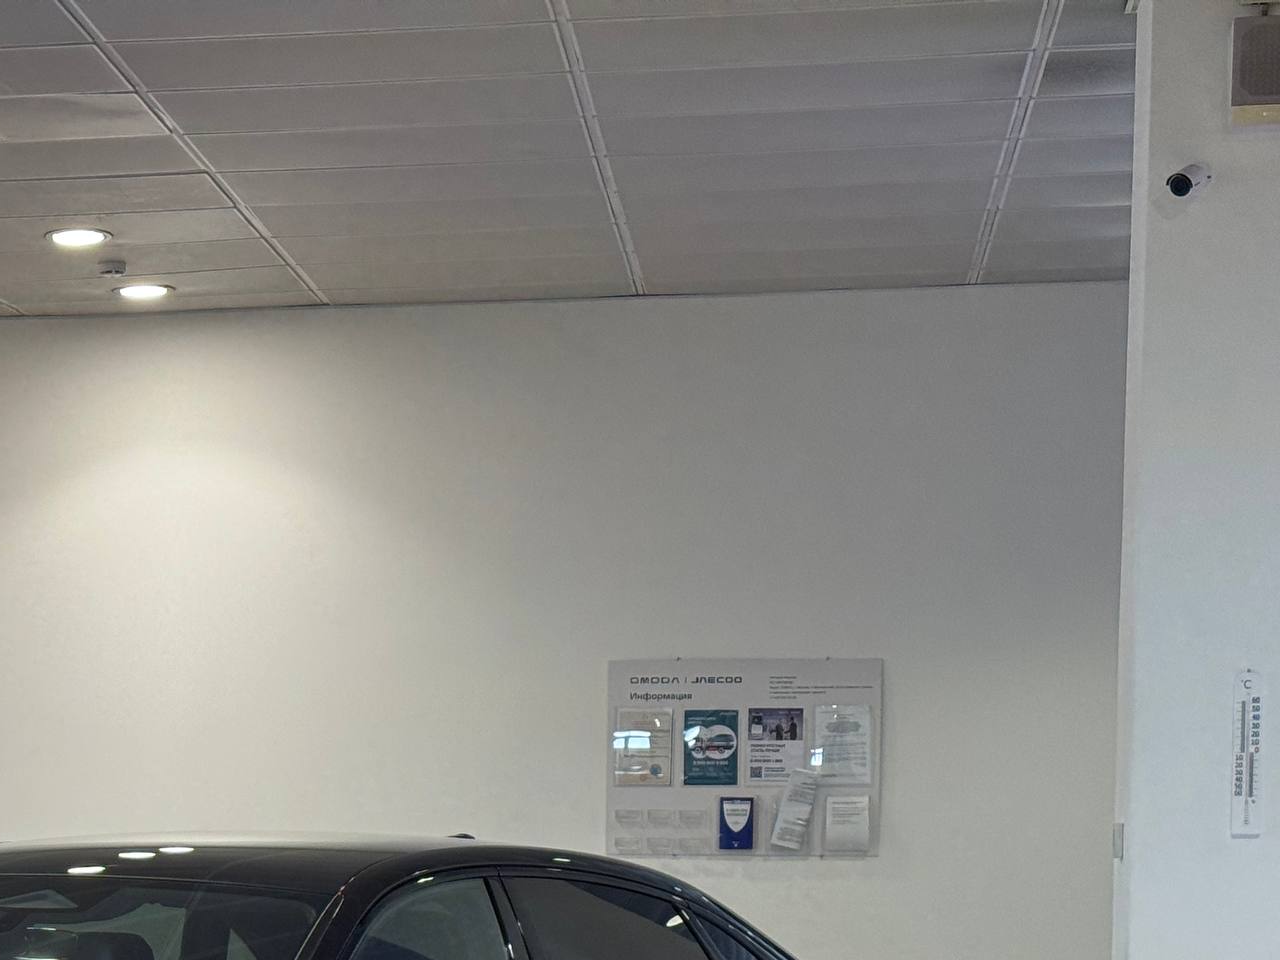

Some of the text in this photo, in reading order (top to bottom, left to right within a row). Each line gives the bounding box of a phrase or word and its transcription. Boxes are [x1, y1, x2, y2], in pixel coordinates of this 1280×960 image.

[630, 676, 743, 684] OMODA JAECOO
[630, 692, 693, 702] Информация
